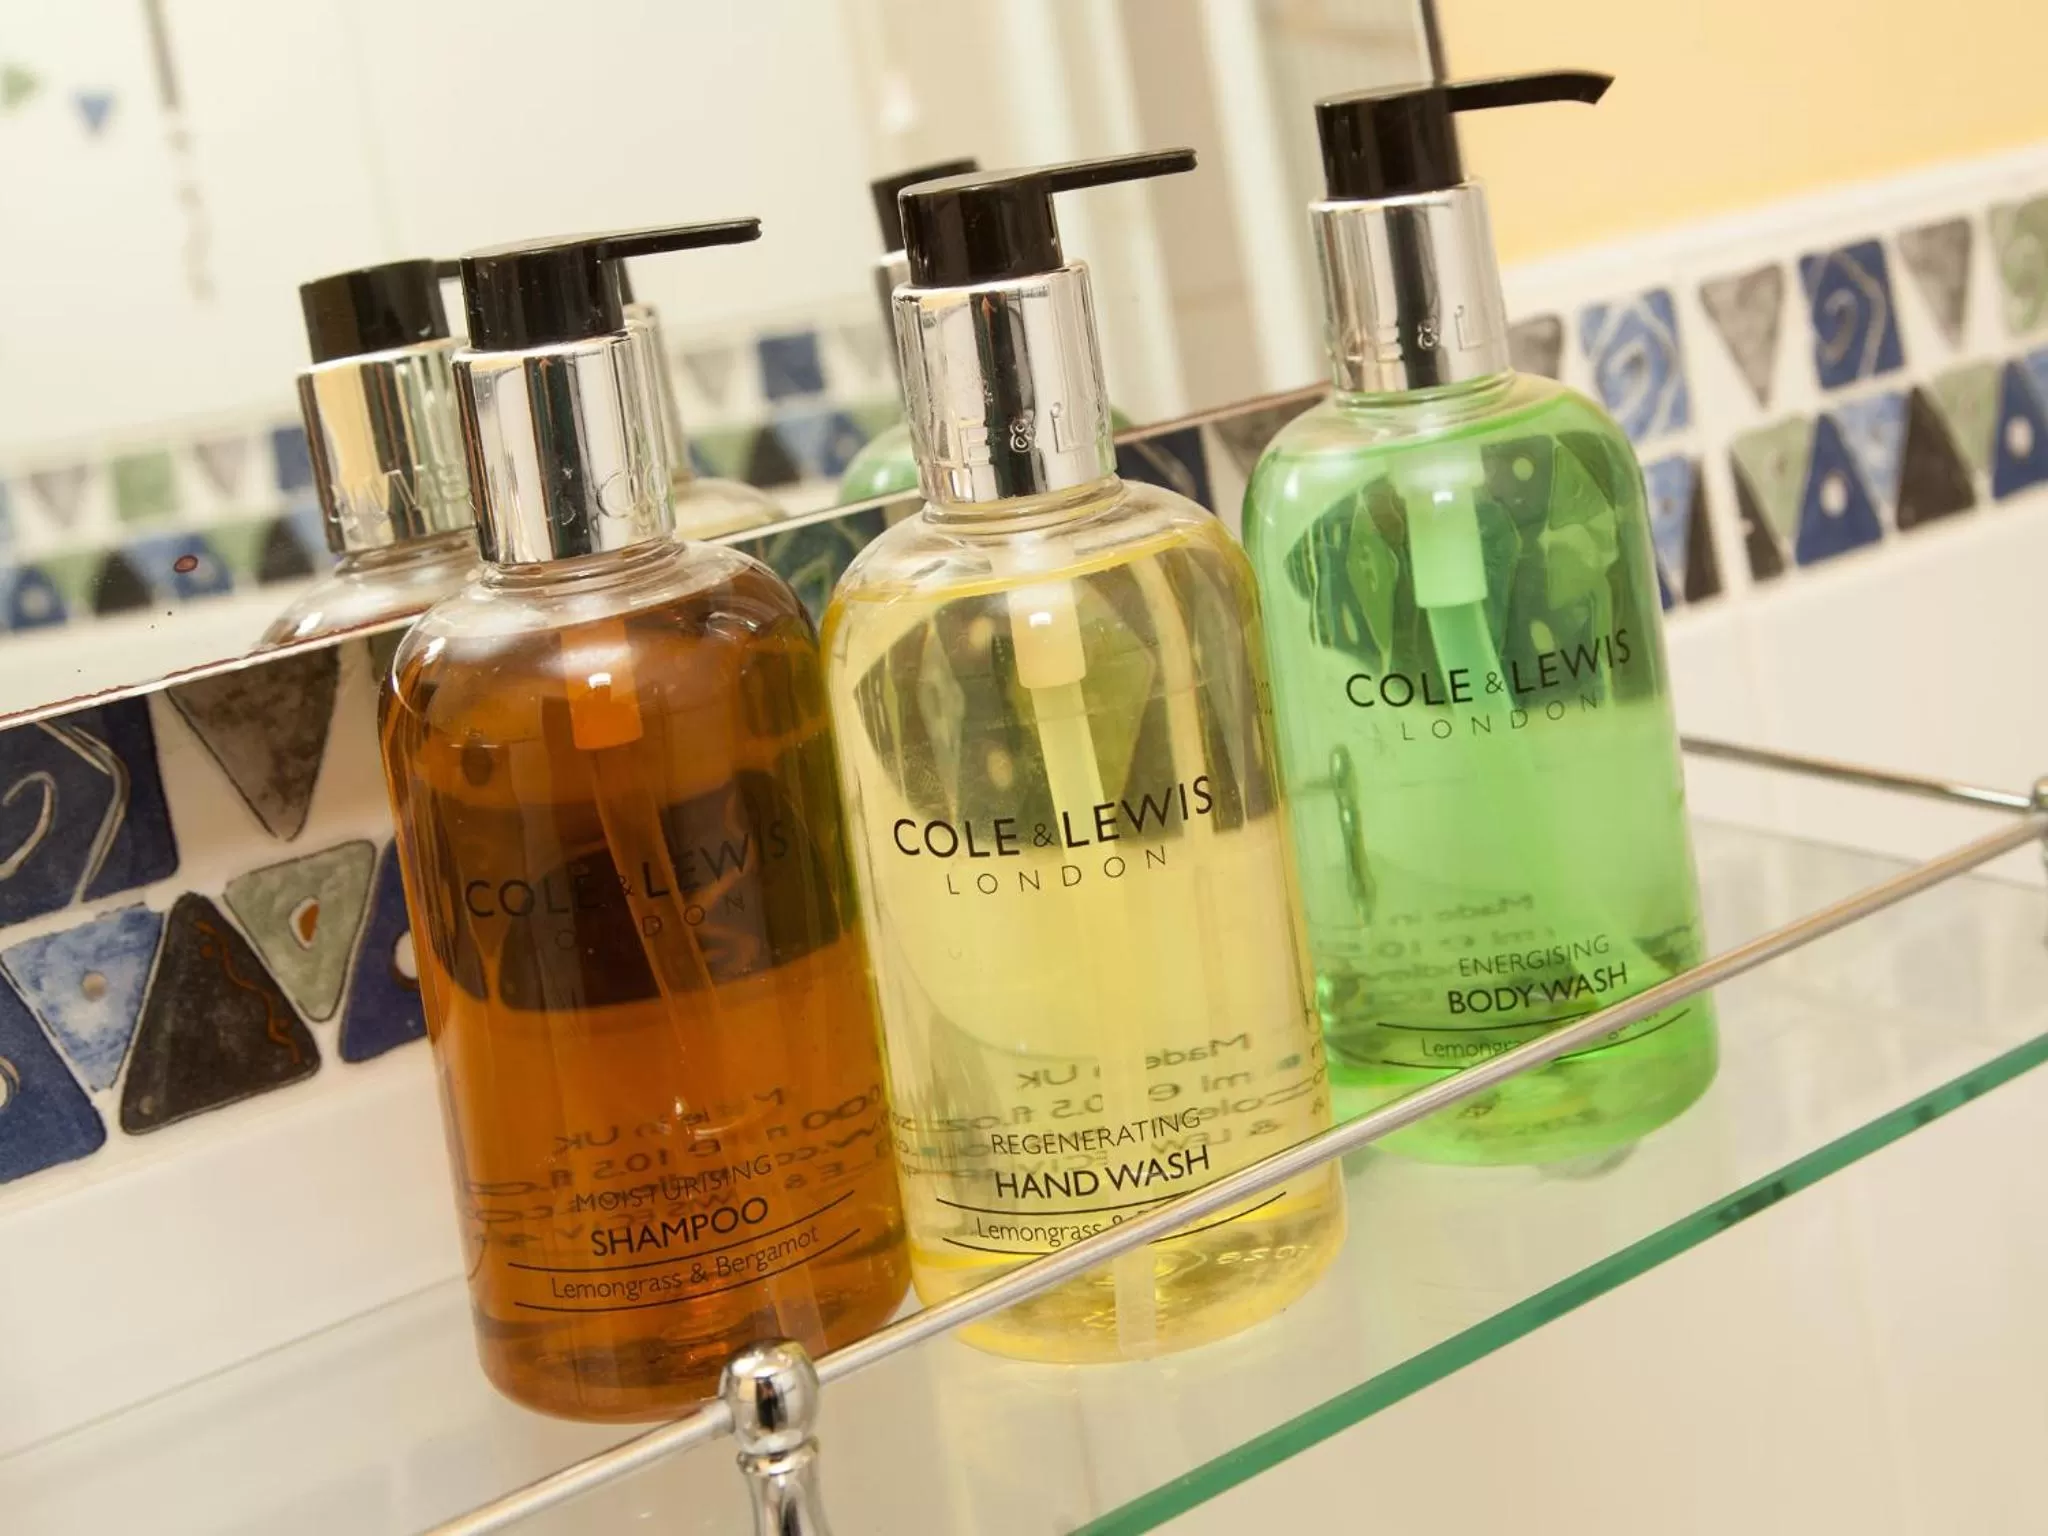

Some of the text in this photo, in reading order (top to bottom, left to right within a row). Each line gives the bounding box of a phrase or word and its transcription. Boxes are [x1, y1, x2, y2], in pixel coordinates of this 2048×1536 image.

[1345, 628, 1632, 708] COLE & LEWIS
[1402, 693, 1601, 742] LONDON
[893, 775, 1214, 859] COLE & LEWIS
[465, 863, 599, 918] COLE
[642, 819, 789, 898] LEWIS
[947, 845, 1167, 896] LONDON
[1459, 934, 1610, 978] ENERGISING
[1448, 985, 1536, 1016] BODY
[1539, 961, 1628, 1005] WASH
[991, 1107, 1202, 1156] REGENERATING
[575, 1157, 773, 1213] MOISTURISING
[994, 1168, 1100, 1200] HAND
[1105, 1144, 1211, 1192] WASH
[590, 1195, 769, 1258] SHAMPOO
[976, 1216, 1102, 1248] Lemongrass
[551, 1224, 821, 1302] Lemongrass & Bergamot
